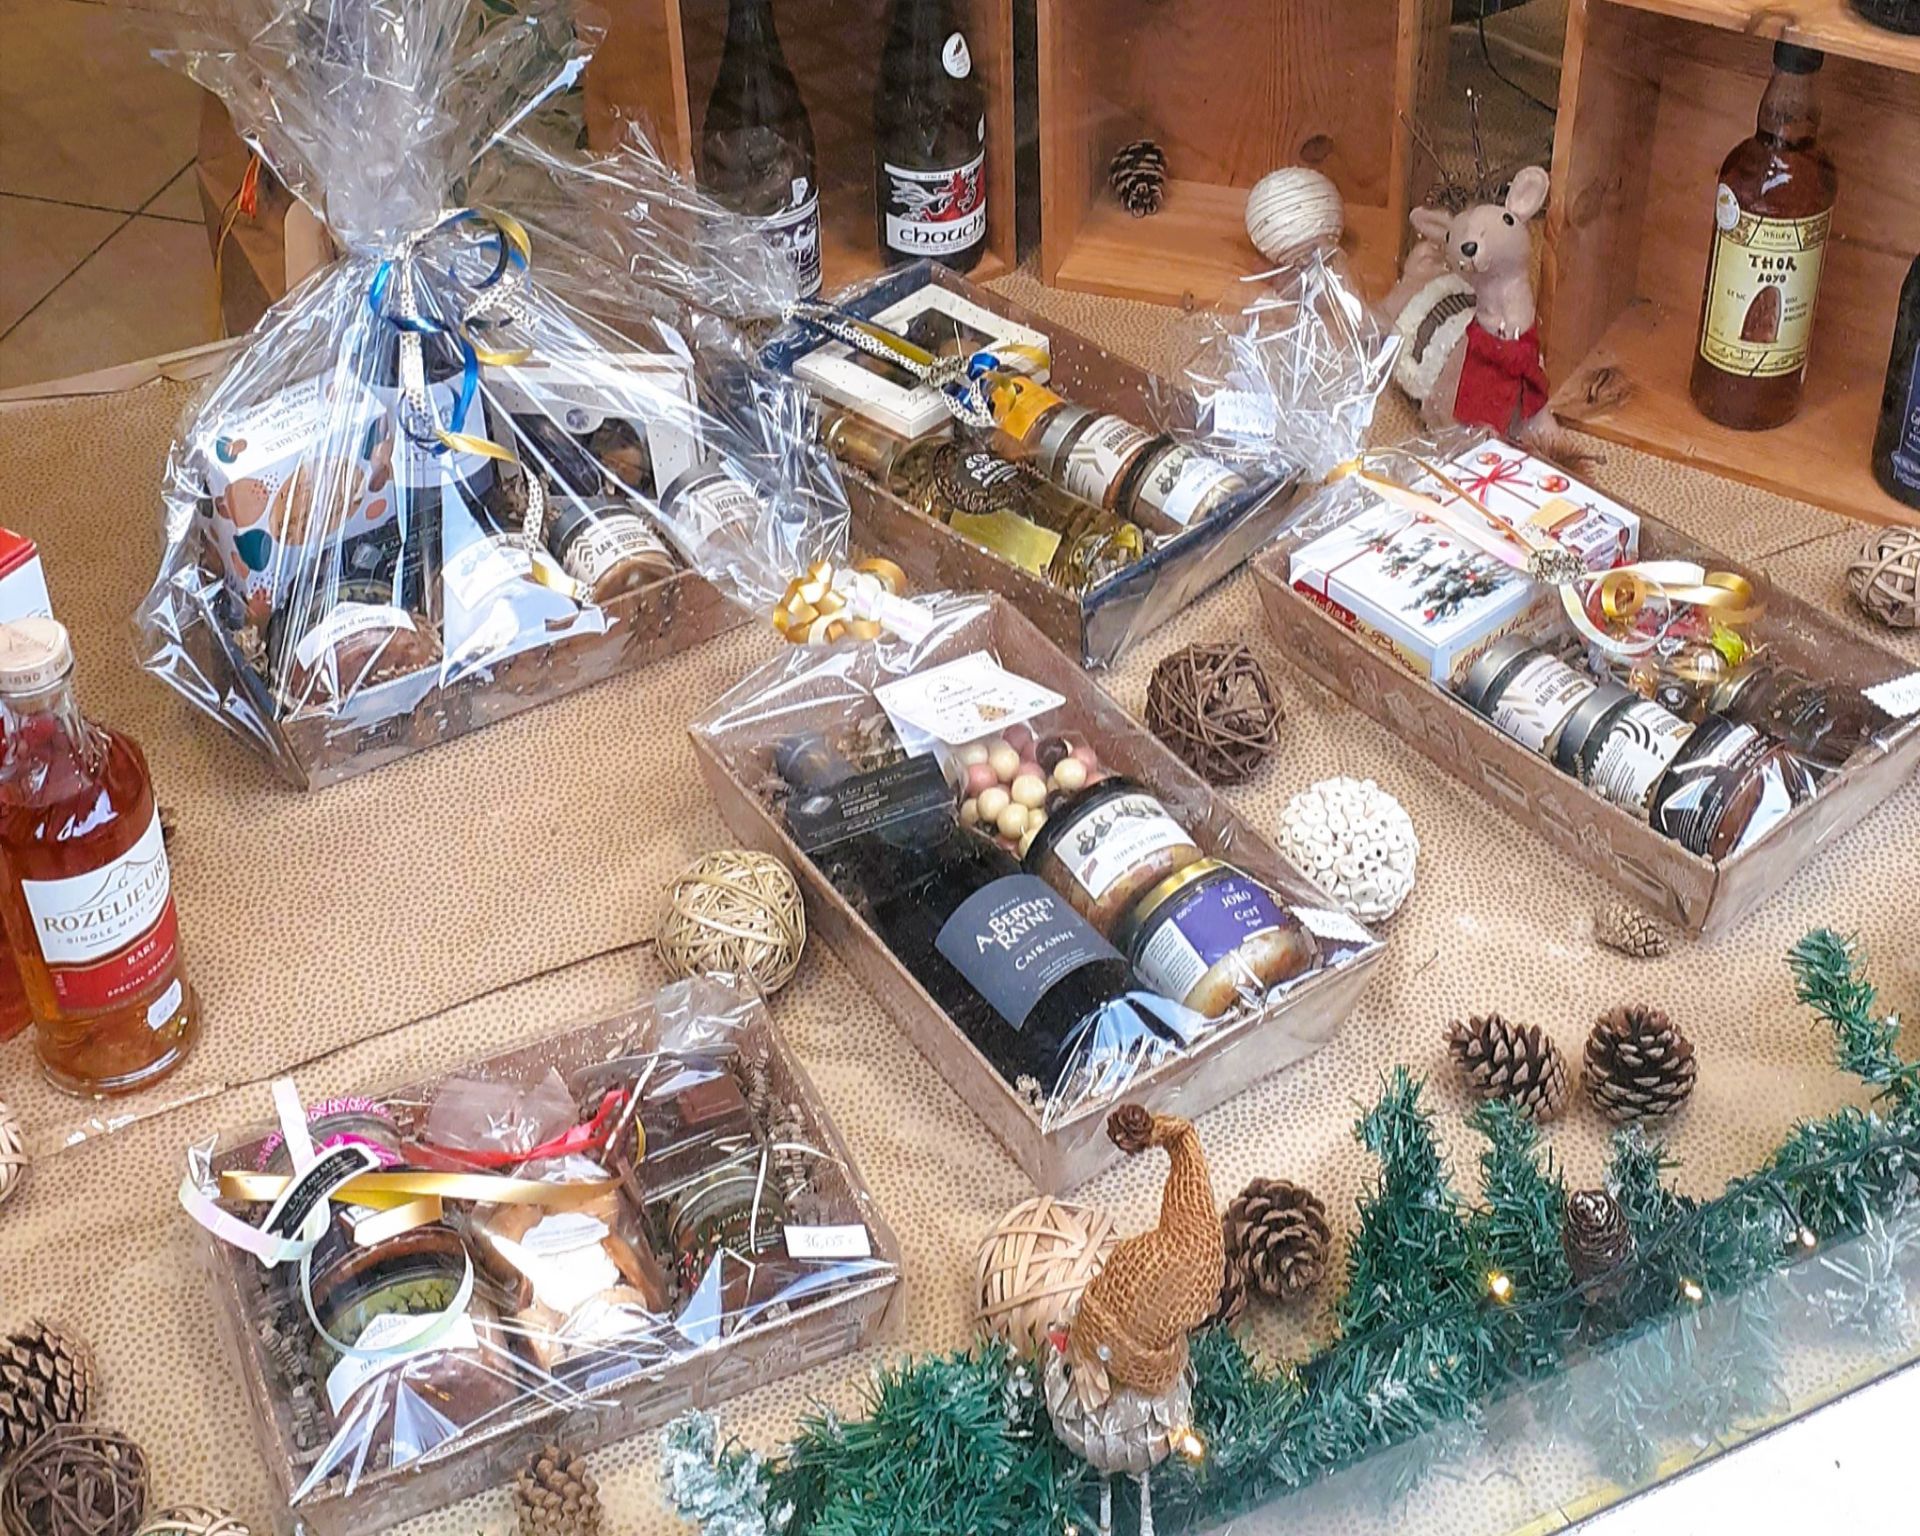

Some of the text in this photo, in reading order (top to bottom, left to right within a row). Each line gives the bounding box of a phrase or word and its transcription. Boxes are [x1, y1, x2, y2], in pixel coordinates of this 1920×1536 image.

[1748, 253, 1798, 272] THOR
[1221, 890, 1252, 909] JOKO
[66, 927, 113, 944] SINGLE
[118, 905, 146, 928] MALT
[996, 909, 1054, 950] RAYNE
[127, 939, 158, 965] RARE
[107, 974, 146, 998] SPECIAL
